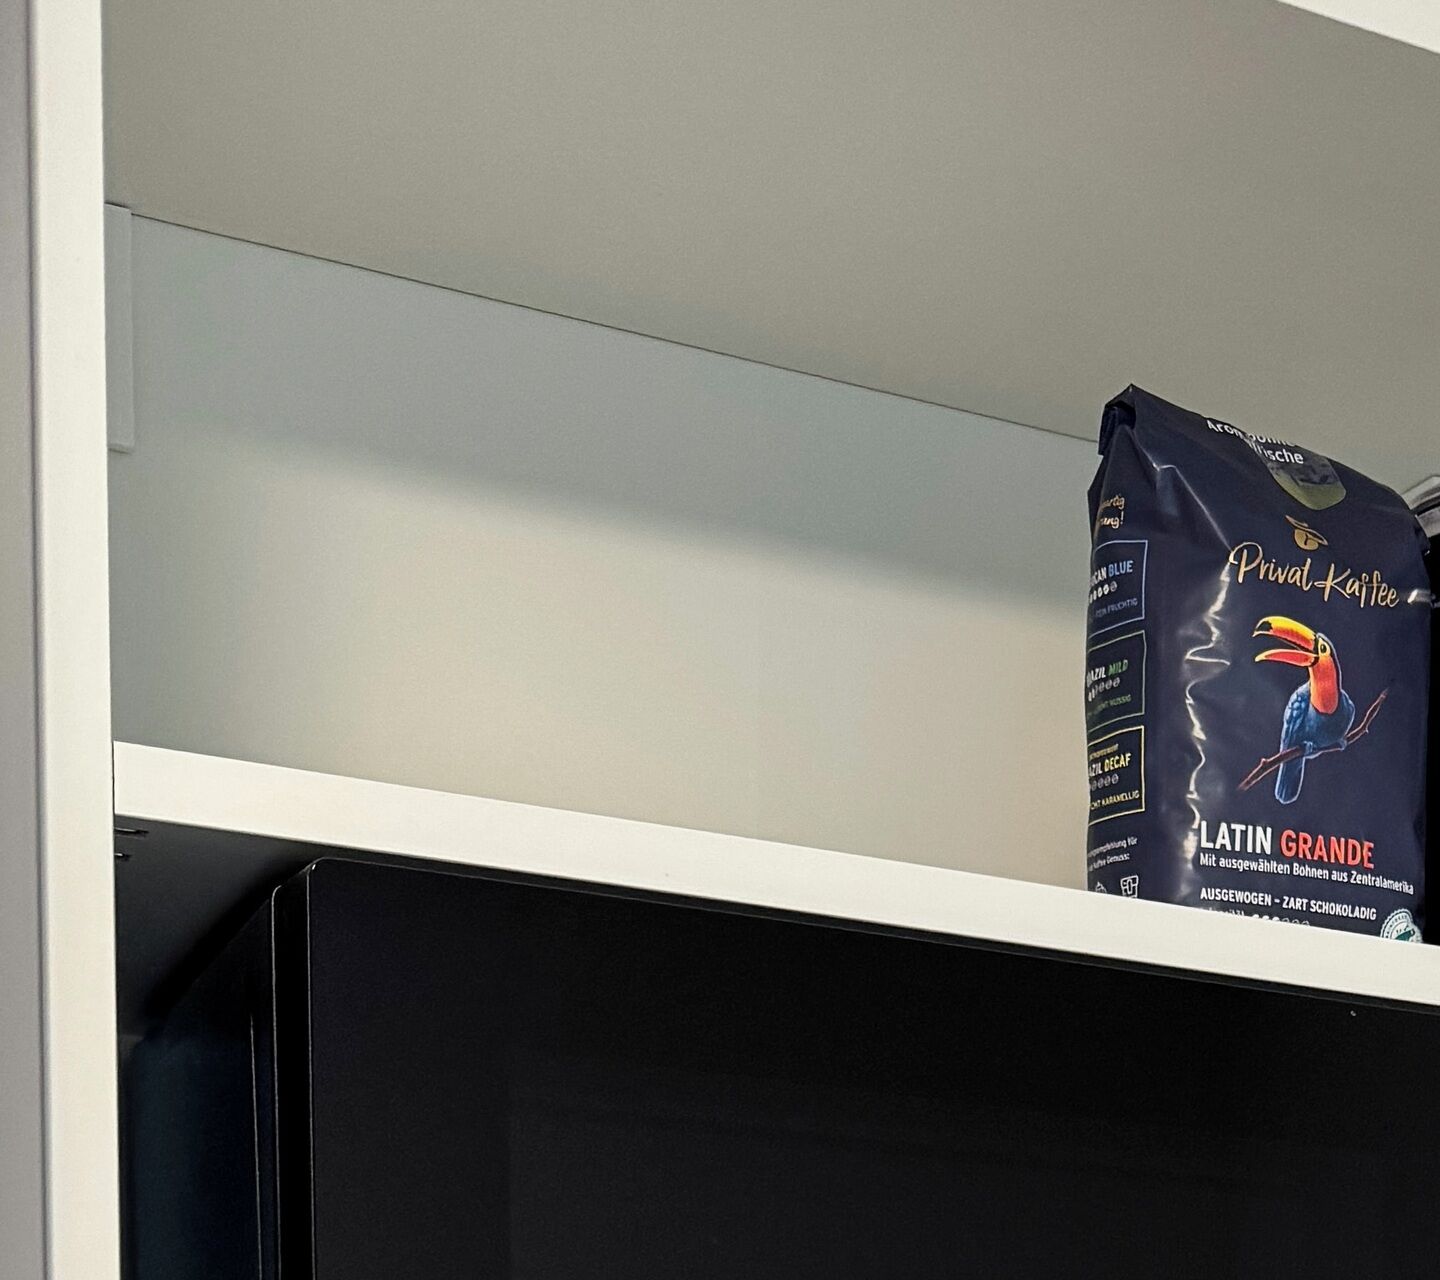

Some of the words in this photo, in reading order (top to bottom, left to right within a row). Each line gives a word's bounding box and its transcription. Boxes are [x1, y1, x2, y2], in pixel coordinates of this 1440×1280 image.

[1108, 560, 1134, 578] BLUE
[1313, 561, 1400, 608] Kaffee
[1108, 659, 1129, 677] MILD
[1103, 752, 1132, 773] DECAF
[1200, 820, 1272, 856] LATIN
[1279, 829, 1375, 869] GRANDE
[1199, 852, 1217, 868] Mit
[1219, 856, 1291, 876] ausgewählten
[1292, 862, 1330, 881] Bohnen
[1330, 870, 1349, 884] aus
[1350, 871, 1415, 895] Zentralamerika
[1199, 887, 1272, 907] AUSGEWOGEN
[1282, 896, 1309, 912] ZART
[1309, 900, 1378, 921] SCHOKOLADIG
